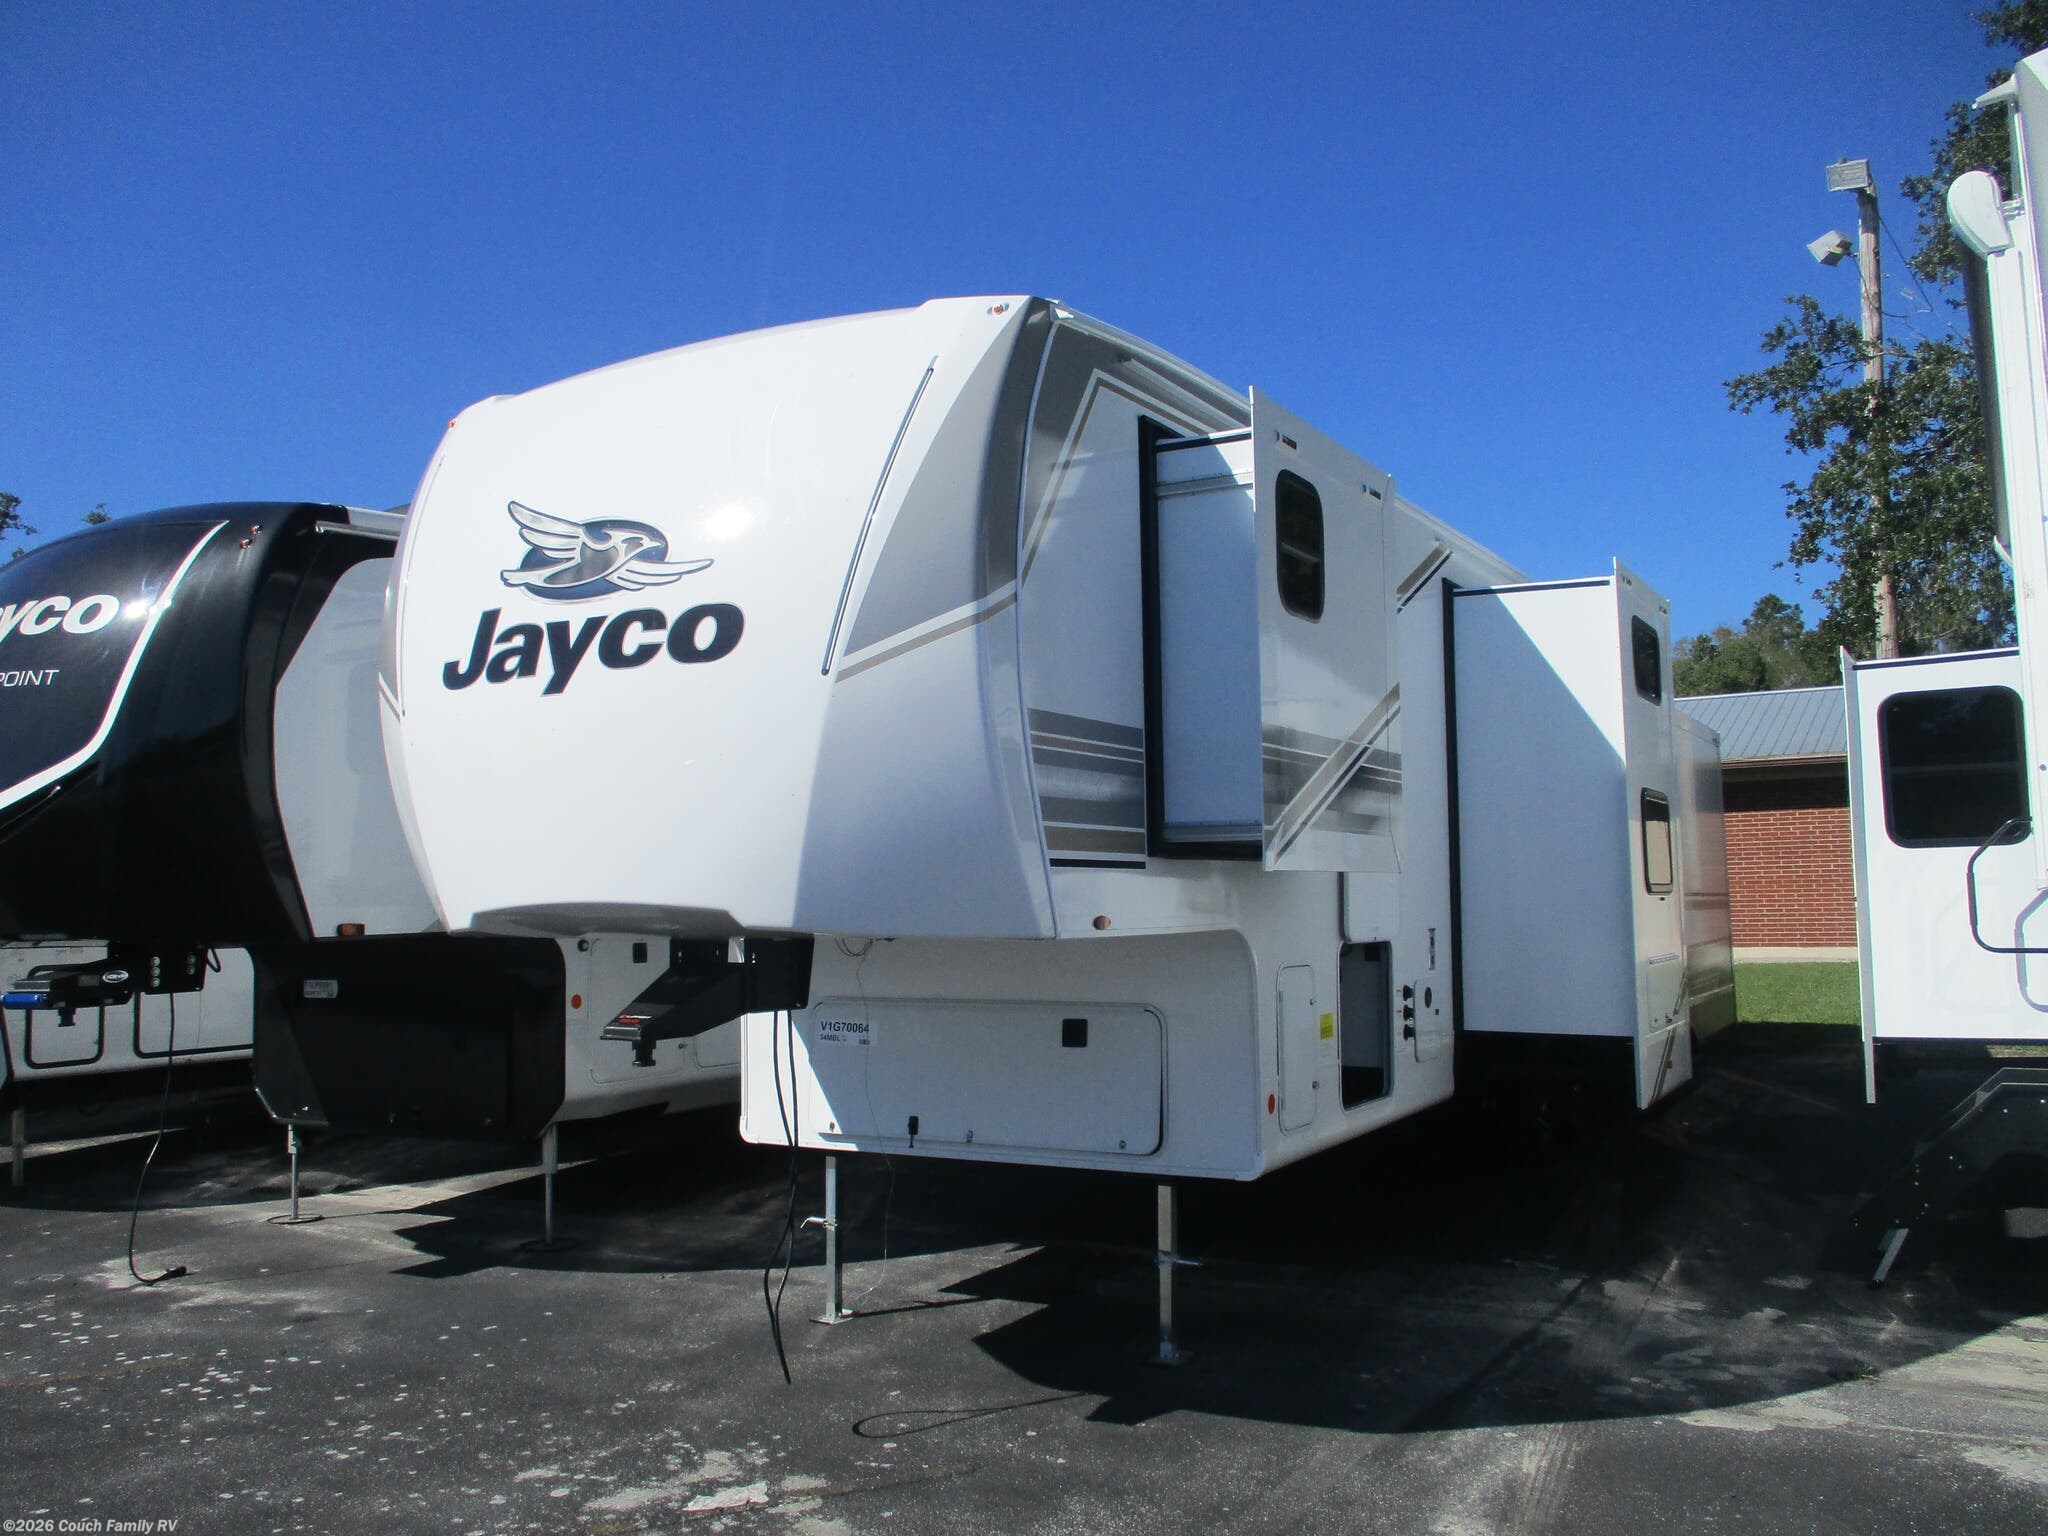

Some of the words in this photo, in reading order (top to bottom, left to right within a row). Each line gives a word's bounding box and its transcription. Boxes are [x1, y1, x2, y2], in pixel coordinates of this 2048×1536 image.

[0, 594, 120, 643] yco
[442, 602, 746, 697] Jayco
[820, 1020, 870, 1034] V1G70064
